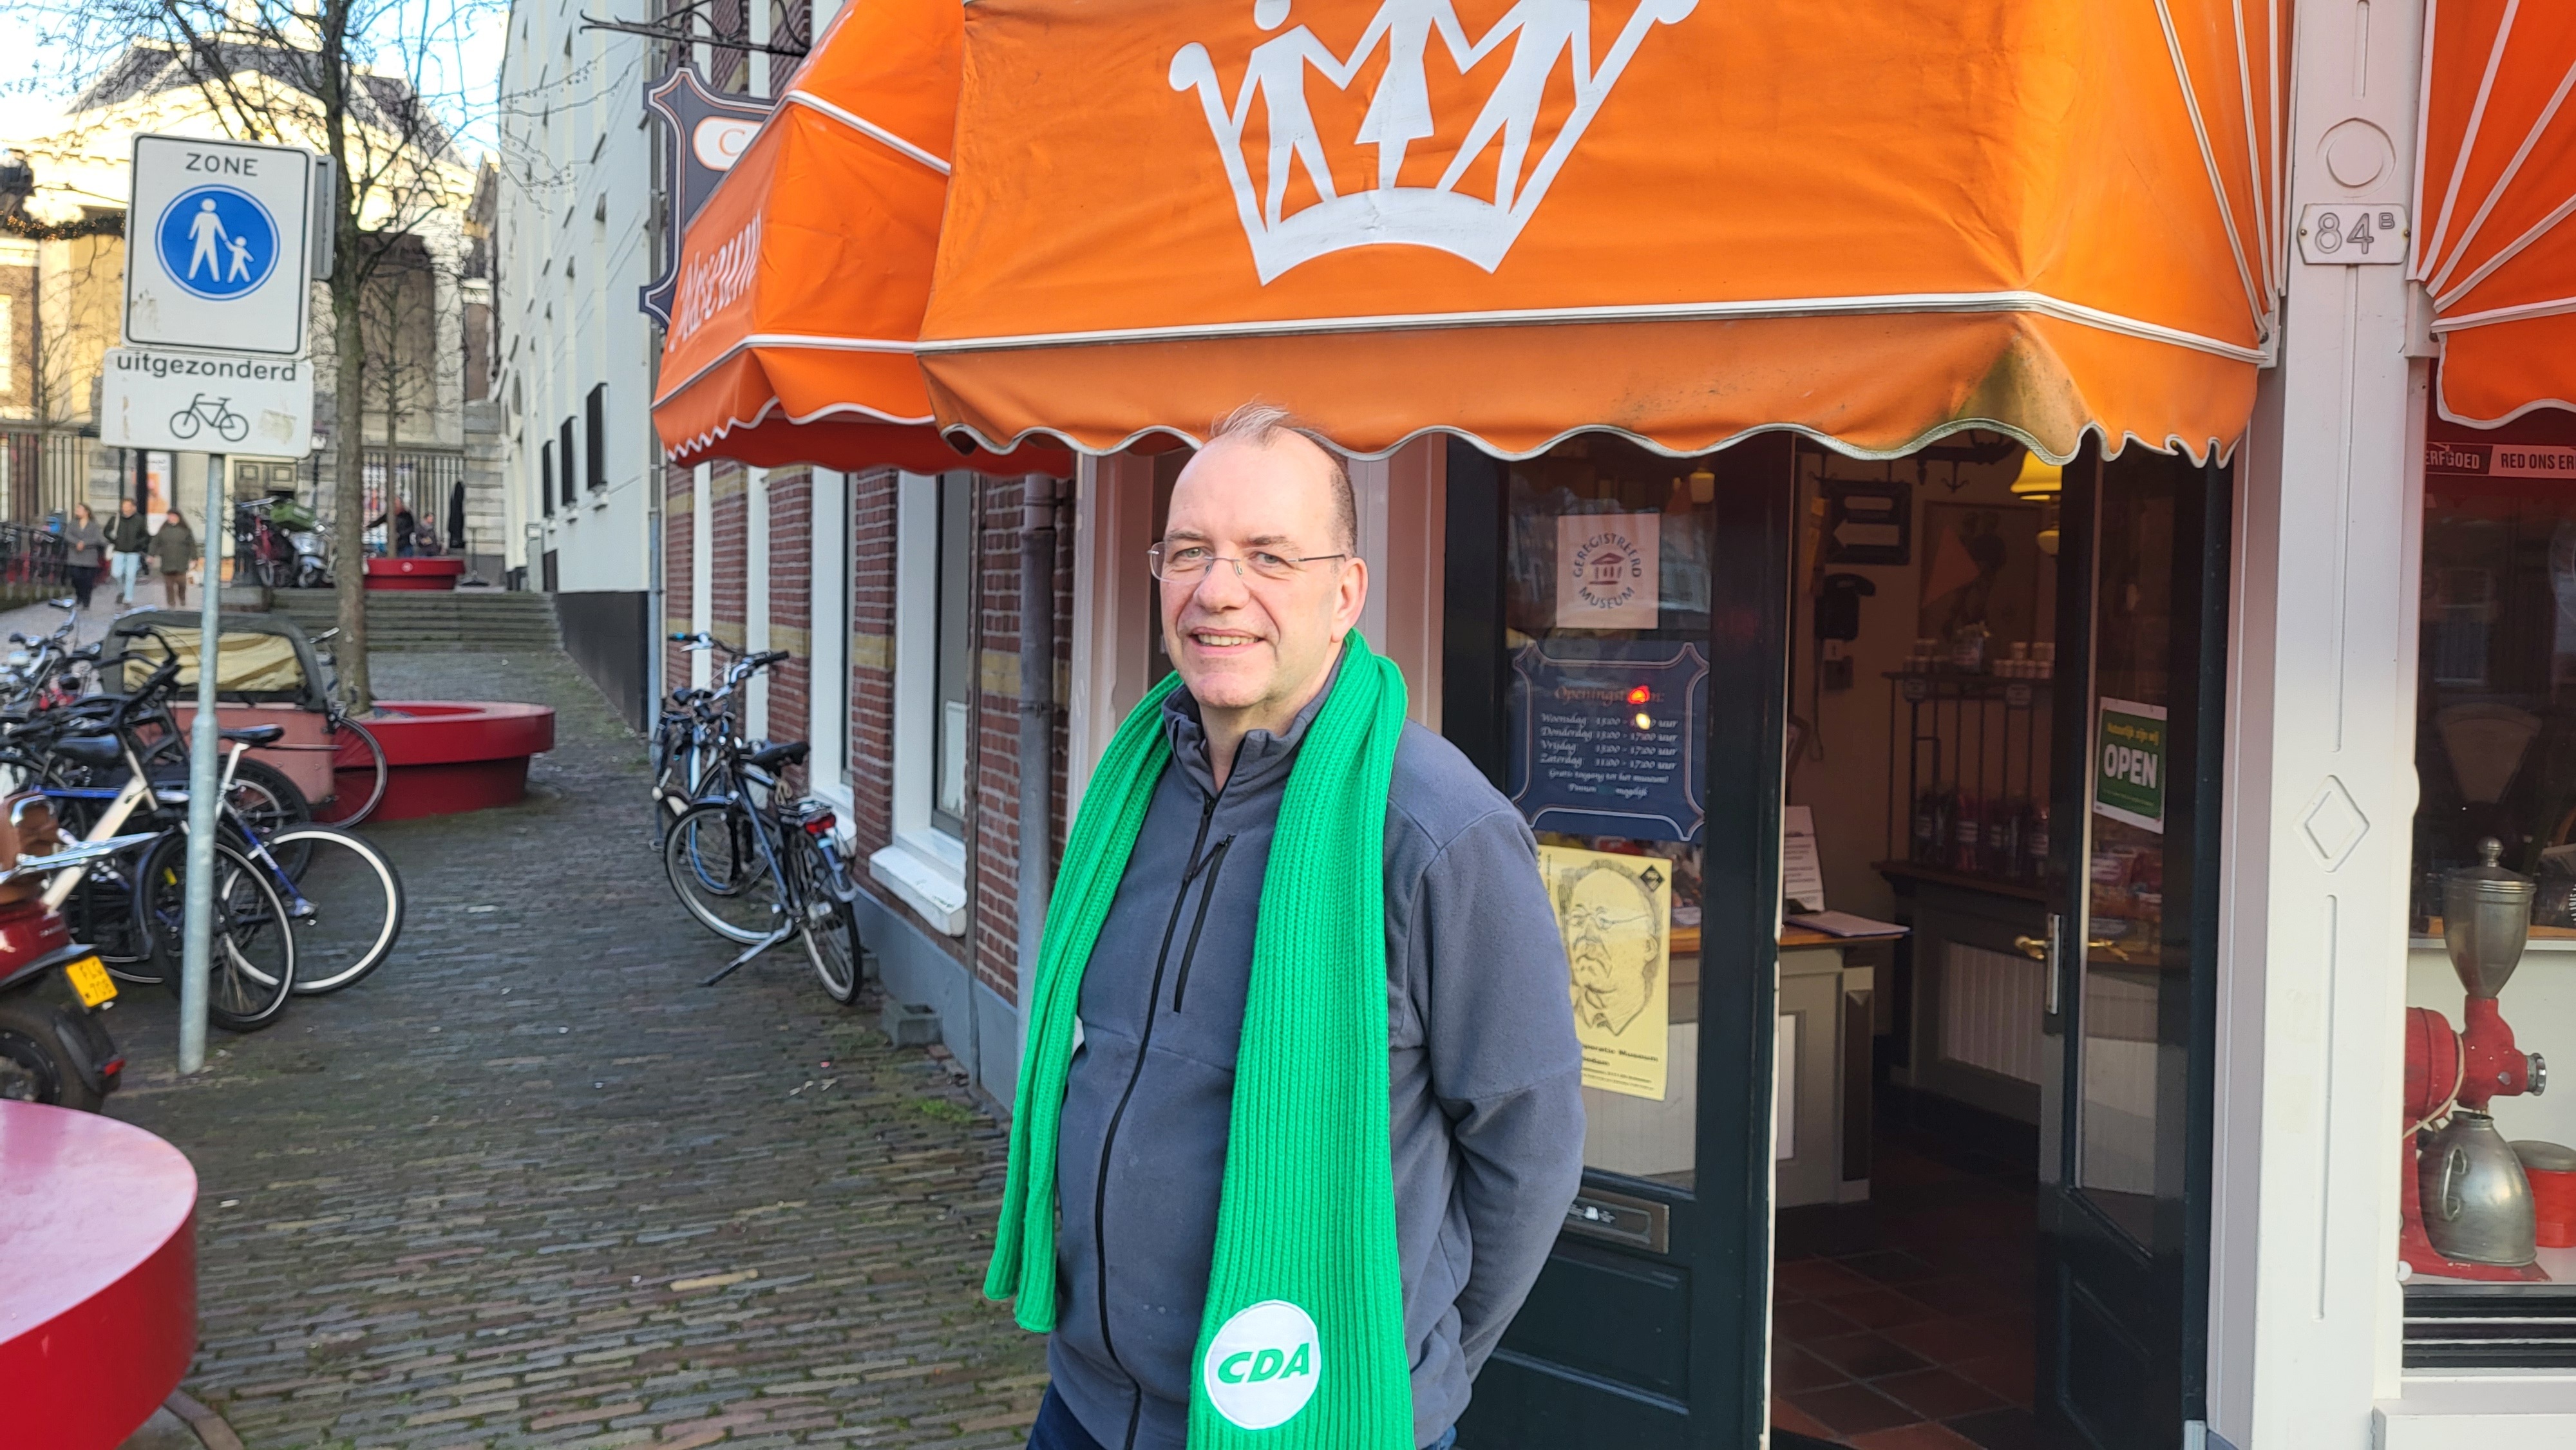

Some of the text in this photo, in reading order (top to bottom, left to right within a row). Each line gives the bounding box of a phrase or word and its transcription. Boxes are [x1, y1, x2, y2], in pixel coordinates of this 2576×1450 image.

[185, 153, 259, 177] ZONE
[116, 352, 298, 382] uitgezonderd
[2501, 453, 2576, 470] RED ONS ER
[1573, 532, 1642, 578] GEREGISTREERD
[1578, 587, 1636, 609] MUSEUM
[1541, 713, 1587, 729] Woensdag
[1540, 726, 1593, 742] Donderdag
[1540, 739, 1577, 756] Vrijdag
[1540, 752, 1583, 769] Zaterdag
[2103, 743, 2158, 789] OPEN
[1218, 1342, 1310, 1384] CDA
